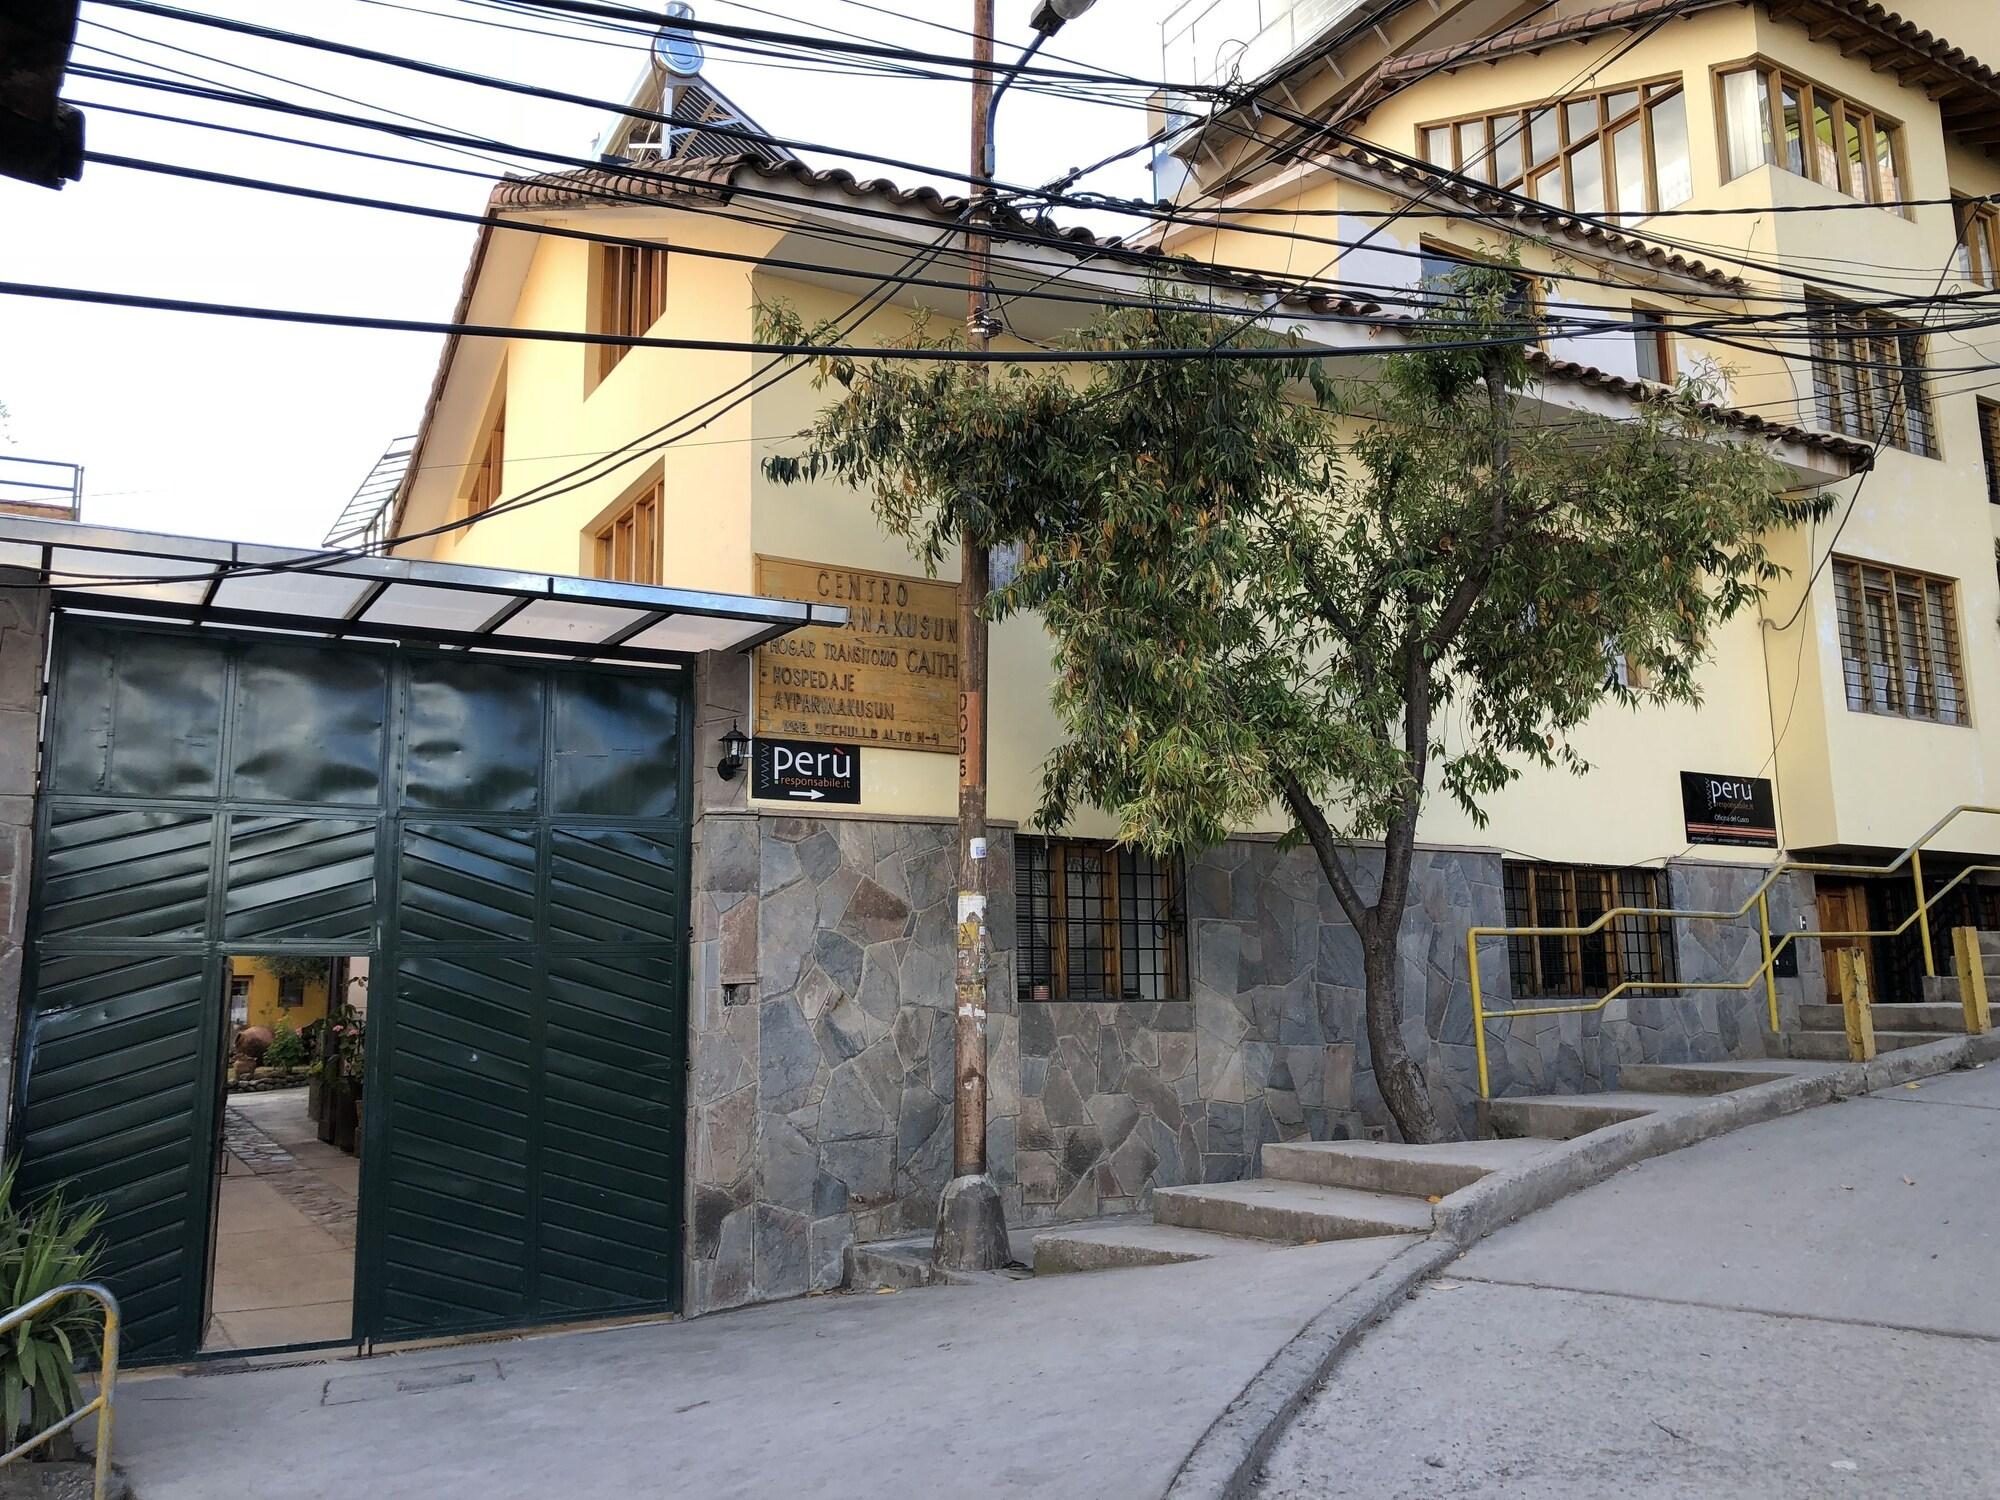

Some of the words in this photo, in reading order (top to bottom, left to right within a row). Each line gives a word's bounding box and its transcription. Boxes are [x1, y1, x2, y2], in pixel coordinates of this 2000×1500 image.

[817, 570, 909, 608] CENTRO
[770, 638, 816, 659] HOGAR
[823, 642, 898, 668] TRANSITORIO
[906, 648, 958, 678] CAITH
[773, 666, 855, 692] HOSPEDAJE
